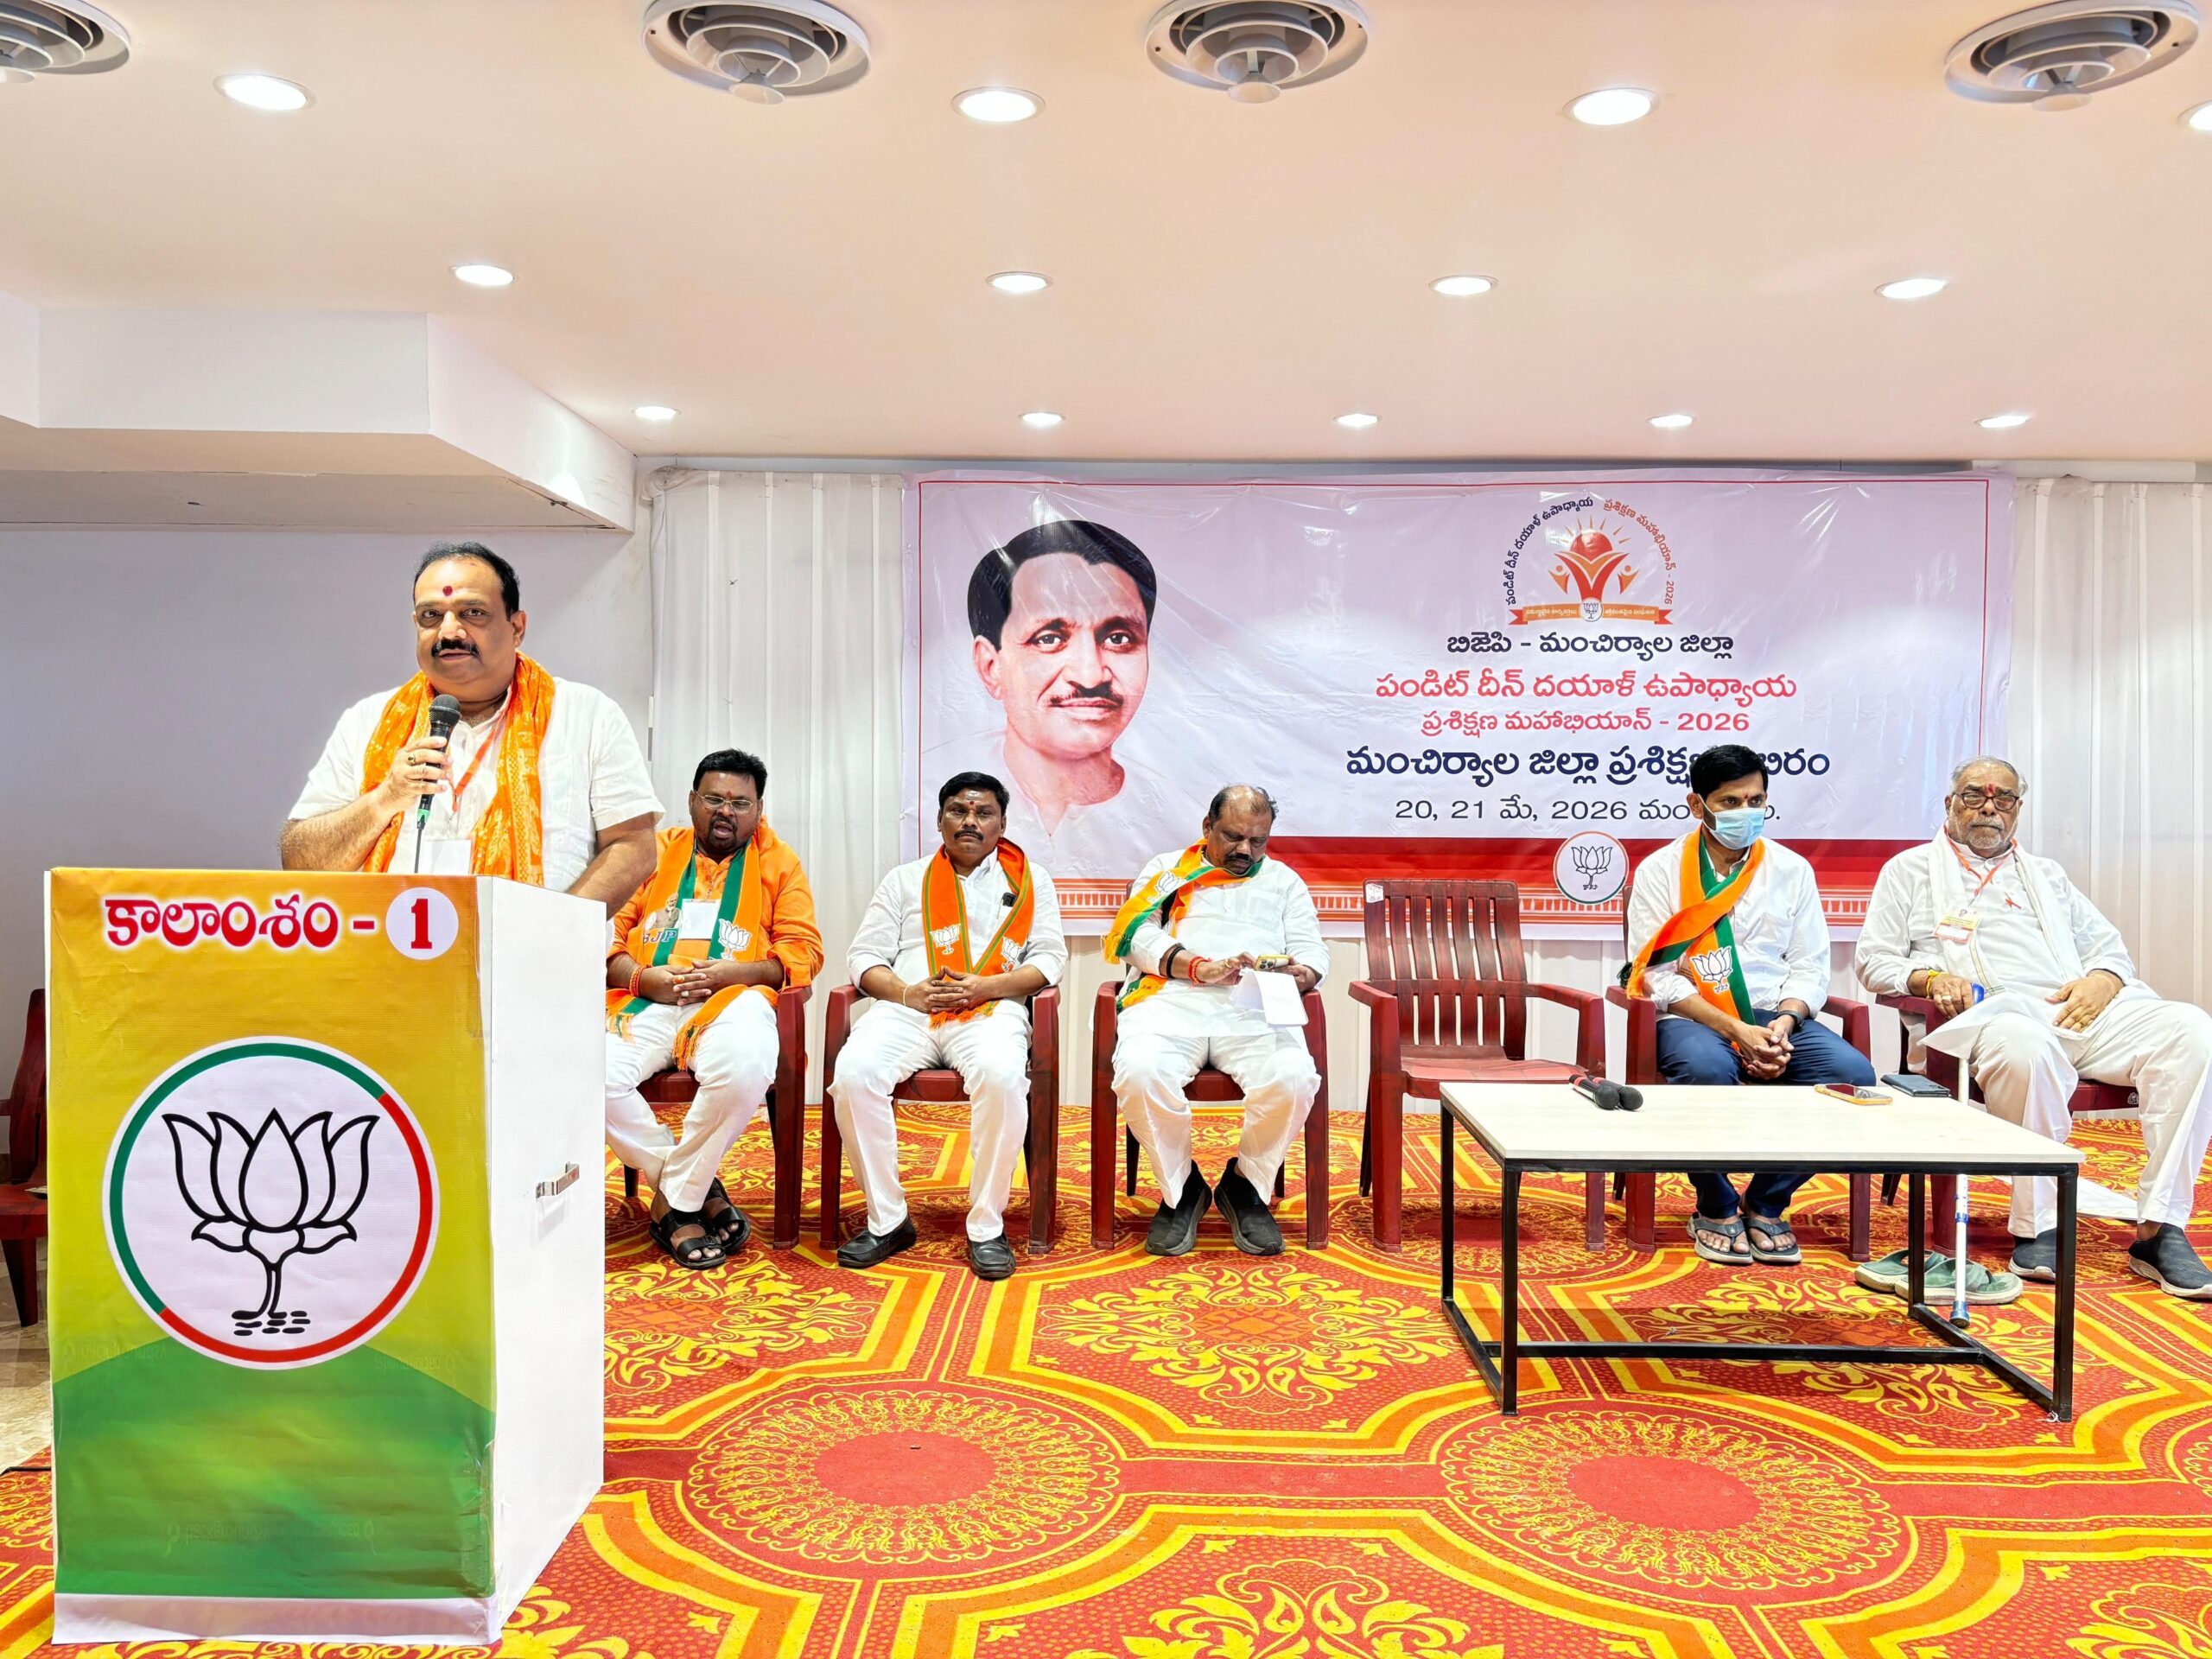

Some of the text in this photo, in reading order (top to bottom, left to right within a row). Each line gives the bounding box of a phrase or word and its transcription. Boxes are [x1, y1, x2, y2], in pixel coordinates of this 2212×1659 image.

[1504, 550, 1519, 569] దీన్
[1604, 499, 1636, 518] ప్రశిక్షణ
[1664, 581, 1675, 605] 2026
[1503, 569, 1516, 605] పండిట్
[1447, 631, 1512, 653] బిజెపి
[1539, 632, 1673, 662] మంచిర్యాల
[1680, 634, 1734, 659] జిల్లా
[1376, 667, 1797, 708] పండిట్ దీన్ దయాళ్ ఉపాధ్యాయ
[1421, 710, 1497, 738] ప్రశిక్షణ
[1504, 708, 1652, 734] మహాభియాన్
[1677, 713, 1750, 731] 2026
[1346, 745, 1830, 788] మంచిర్యాల జిల్లా ప్రశిక్ష బిరం
[1395, 800, 1438, 821] 20,
[1451, 800, 1483, 818] 21
[1500, 794, 1538, 821] మే,
[1551, 801, 1627, 820] 2026
[105, 893, 339, 949] కాలాంశం
[410, 899, 432, 950] 1
